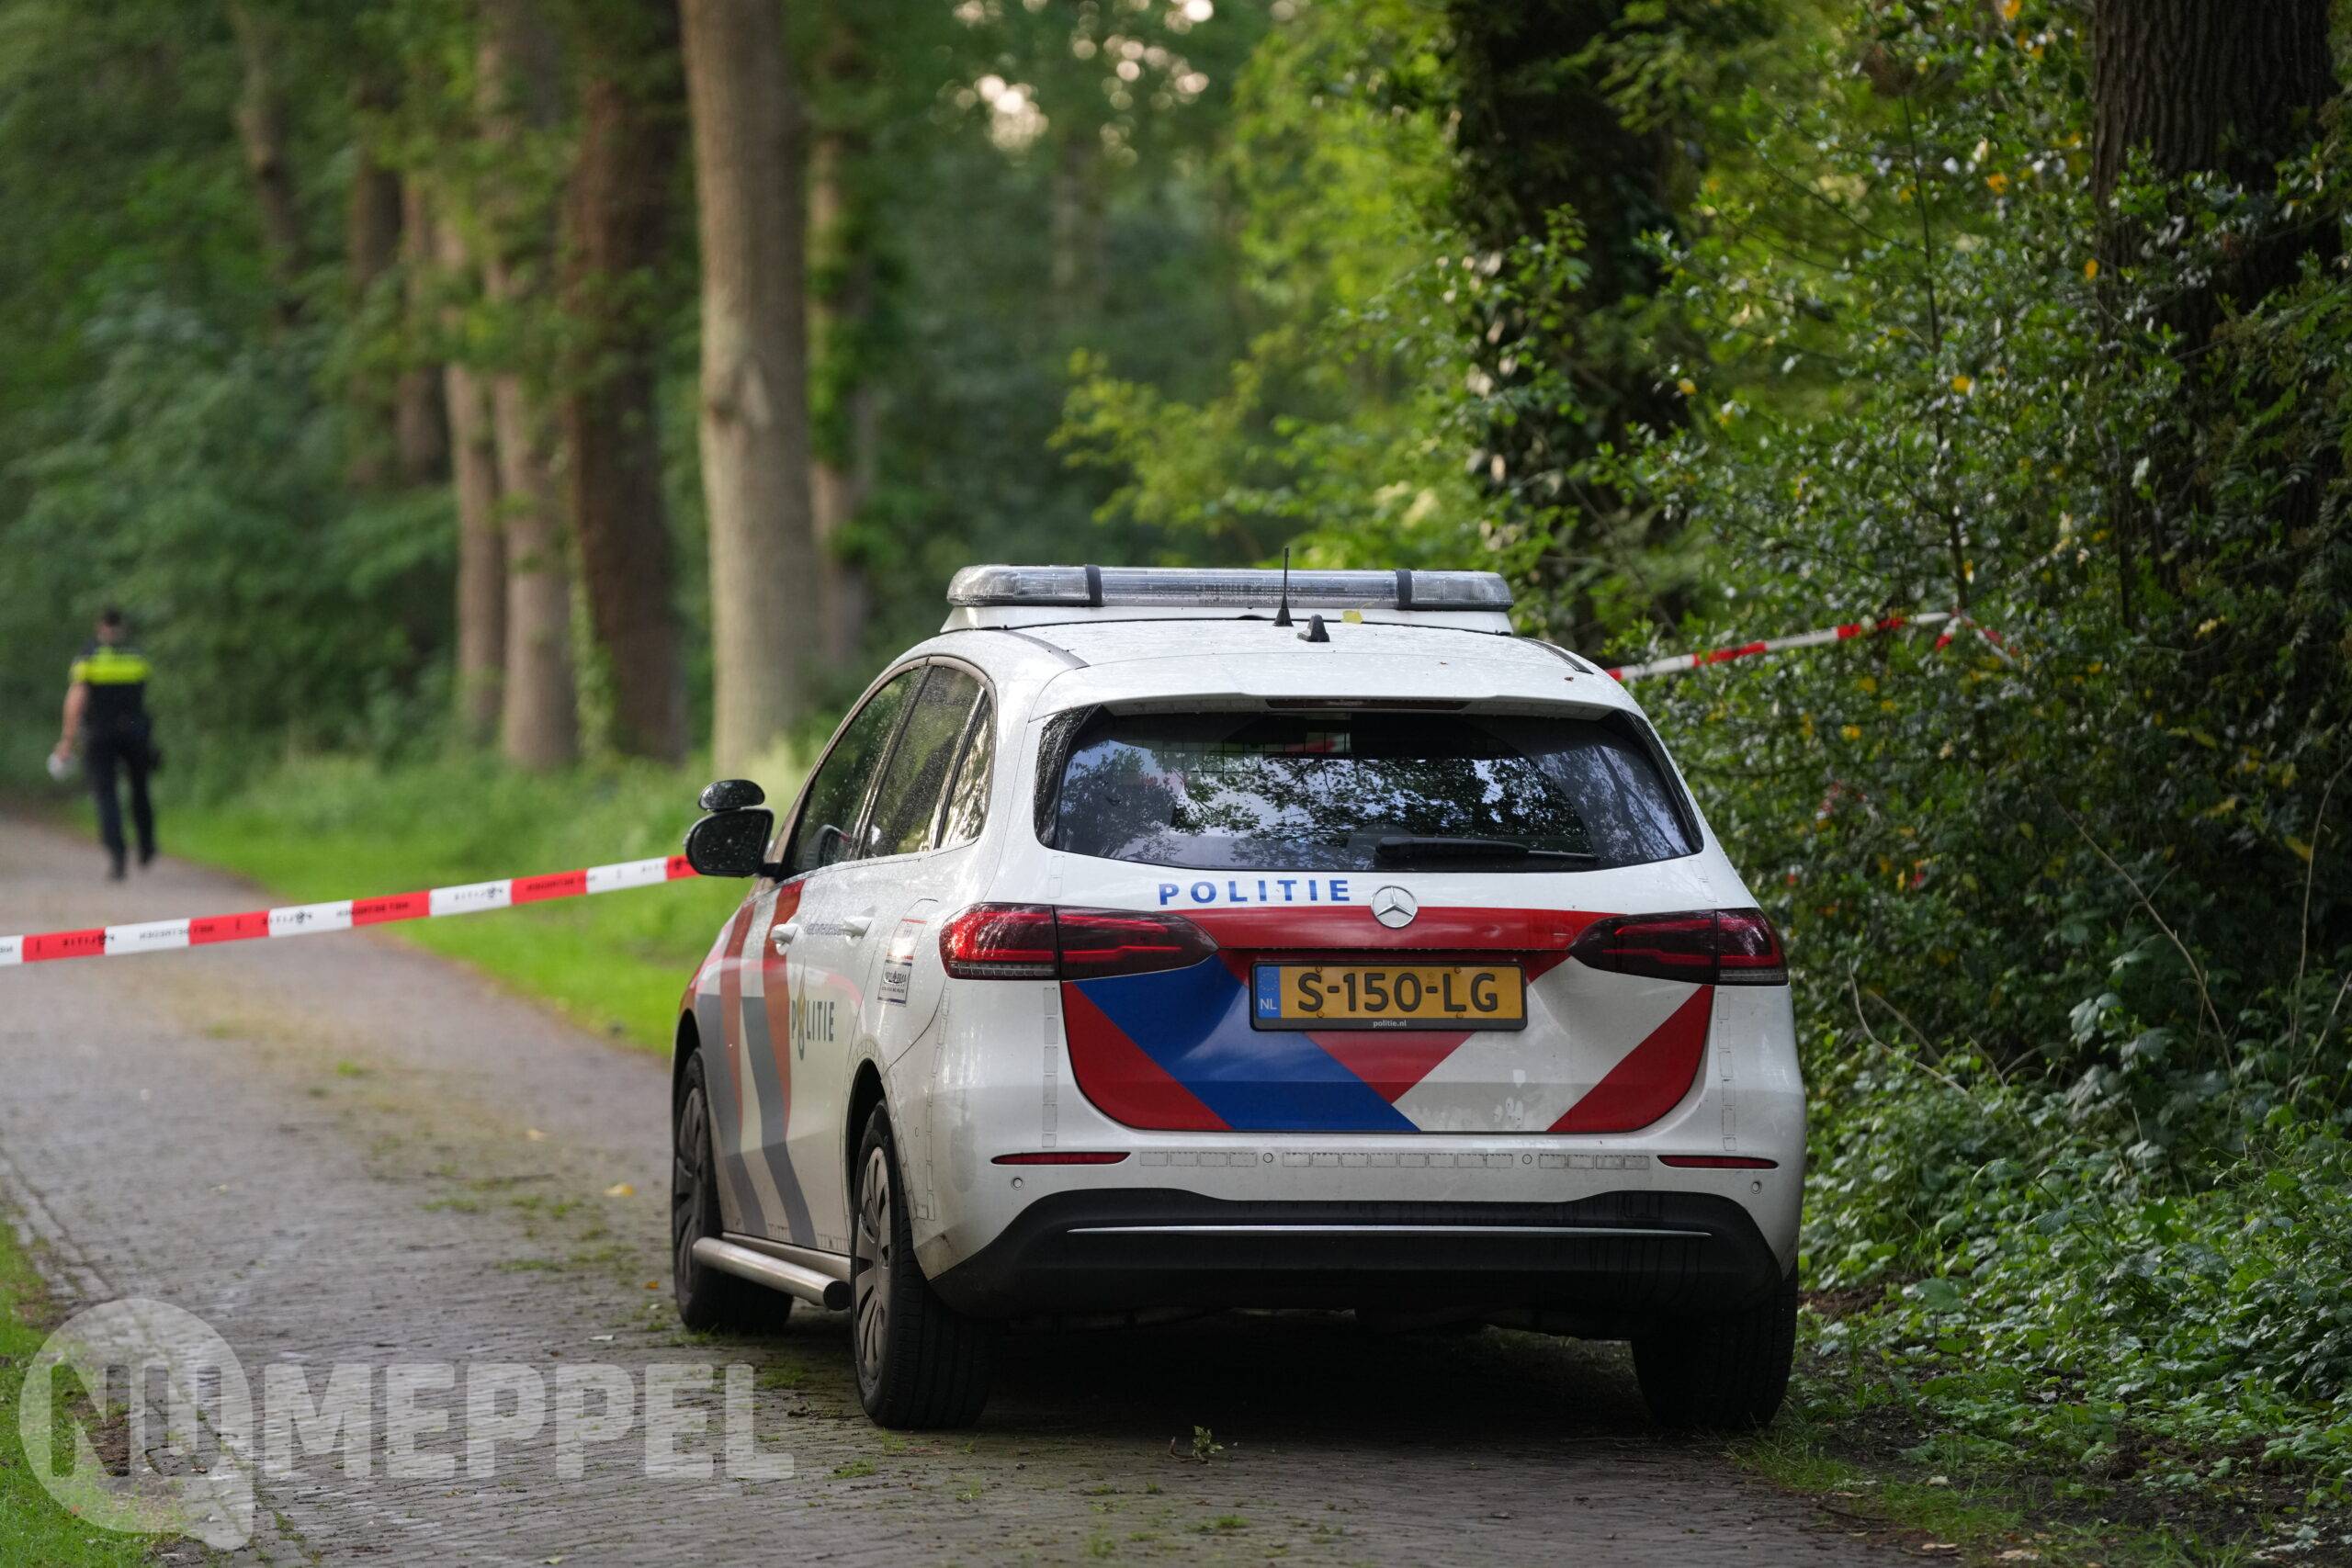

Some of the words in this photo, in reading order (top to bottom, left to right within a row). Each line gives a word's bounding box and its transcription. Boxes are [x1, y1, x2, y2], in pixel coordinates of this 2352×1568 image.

[1159, 879, 1351, 905] POLITIE
[1297, 972, 1498, 1012] S-150-LG
[1260, 998, 1278, 1010] NL
[1373, 1019, 1408, 1028] politie.nl
